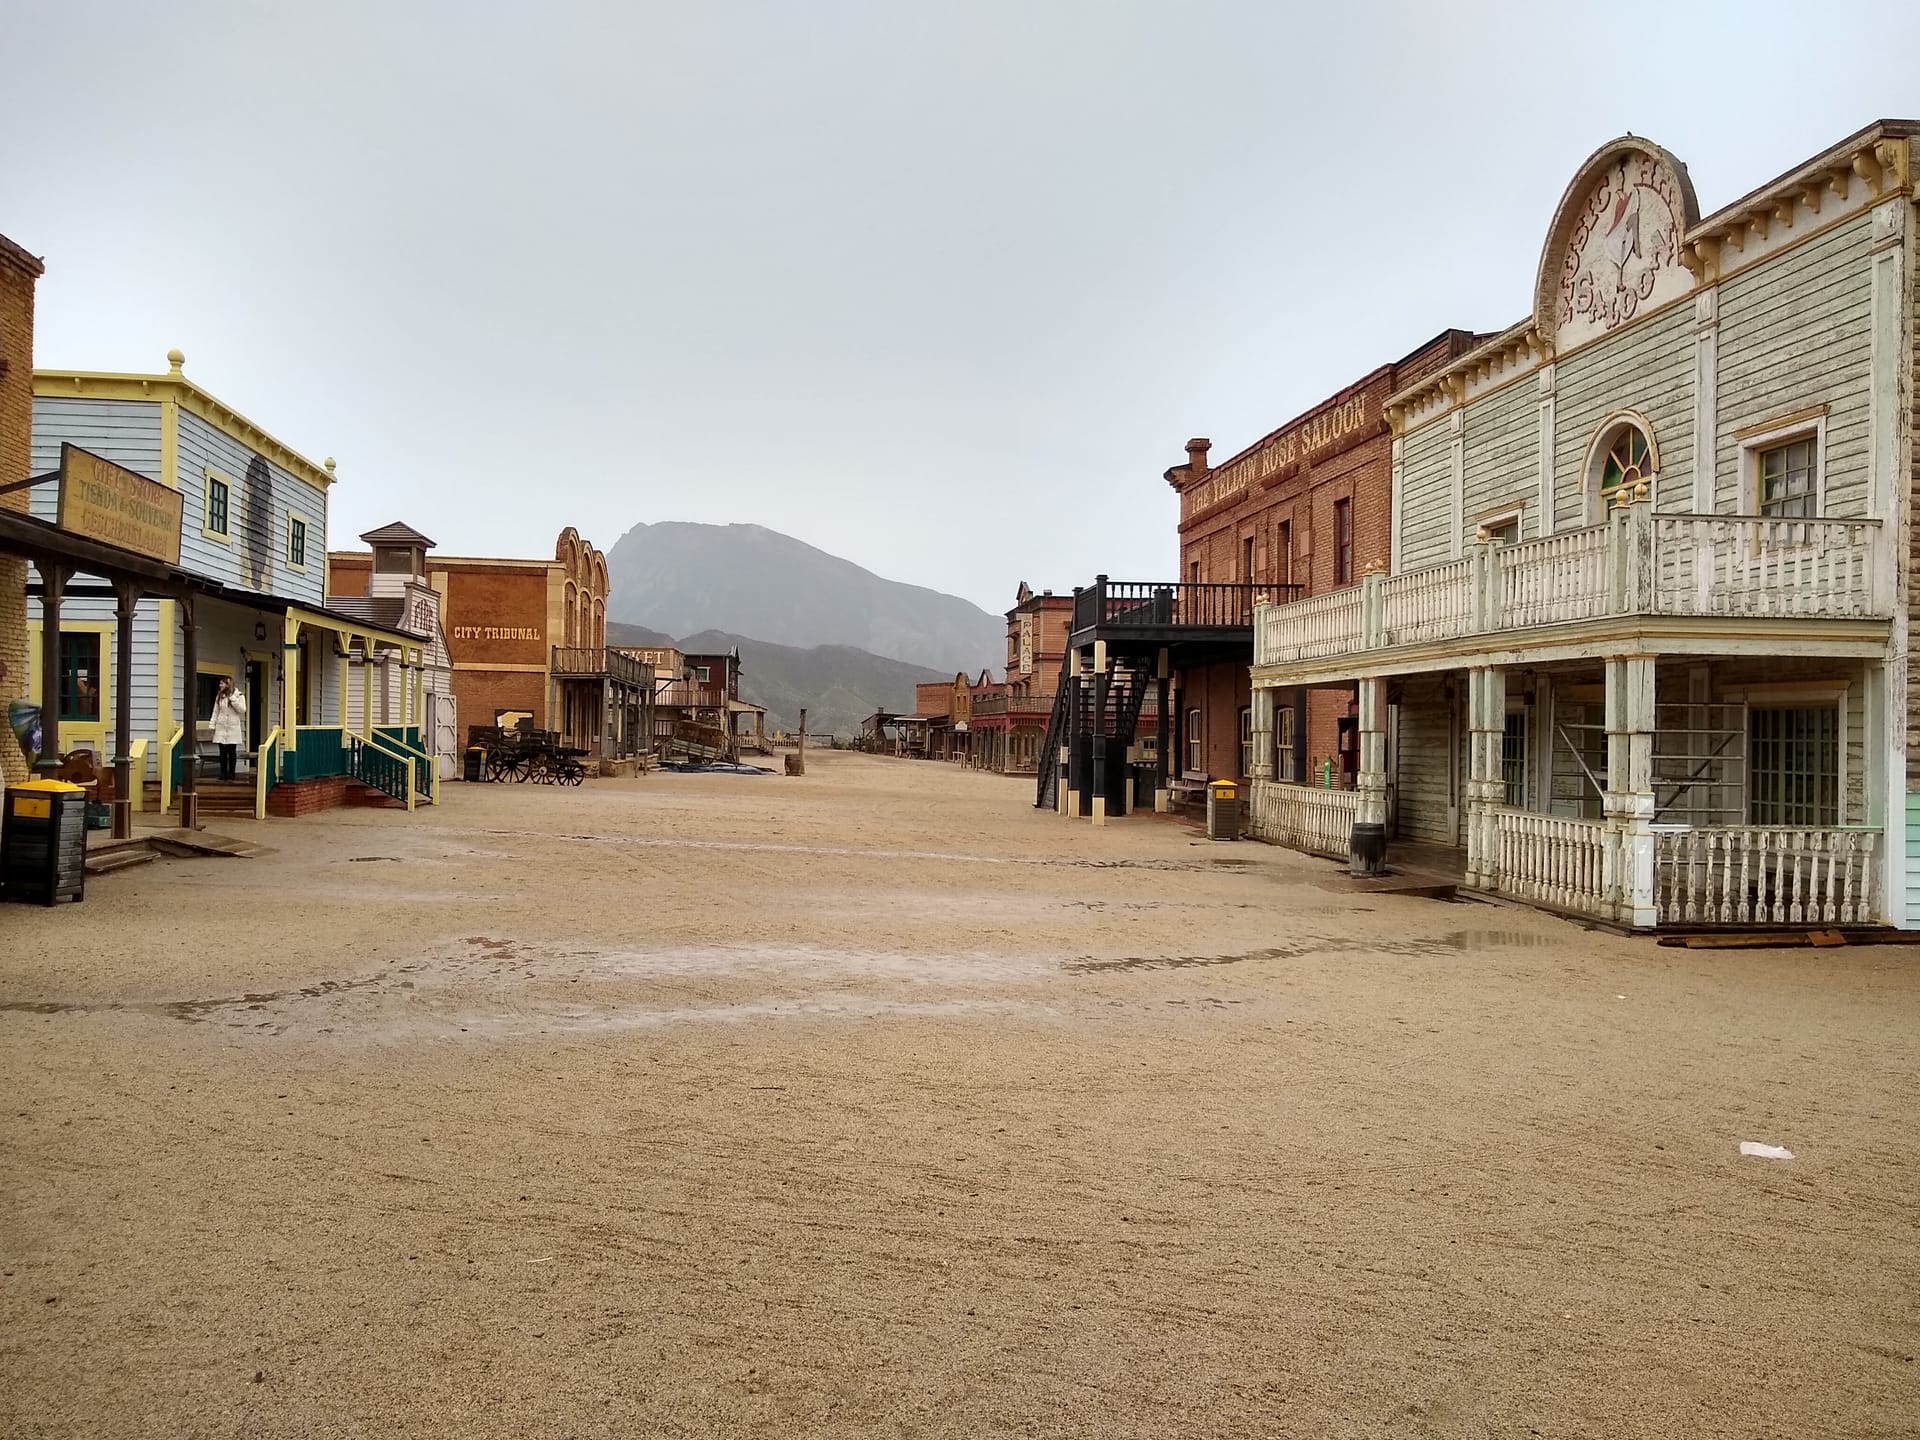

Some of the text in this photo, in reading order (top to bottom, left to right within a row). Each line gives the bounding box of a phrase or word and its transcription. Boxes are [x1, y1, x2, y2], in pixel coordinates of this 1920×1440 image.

[1576, 221, 1676, 330] SALOON
[1191, 392, 1366, 514] THE YELLOW ROSE SALOON
[79, 480, 118, 513] TIENDA
[94, 459, 164, 510] GIFT STORE
[454, 626, 540, 641] CITY TRIBUNAL
[1022, 621, 1031, 672] PALACE
